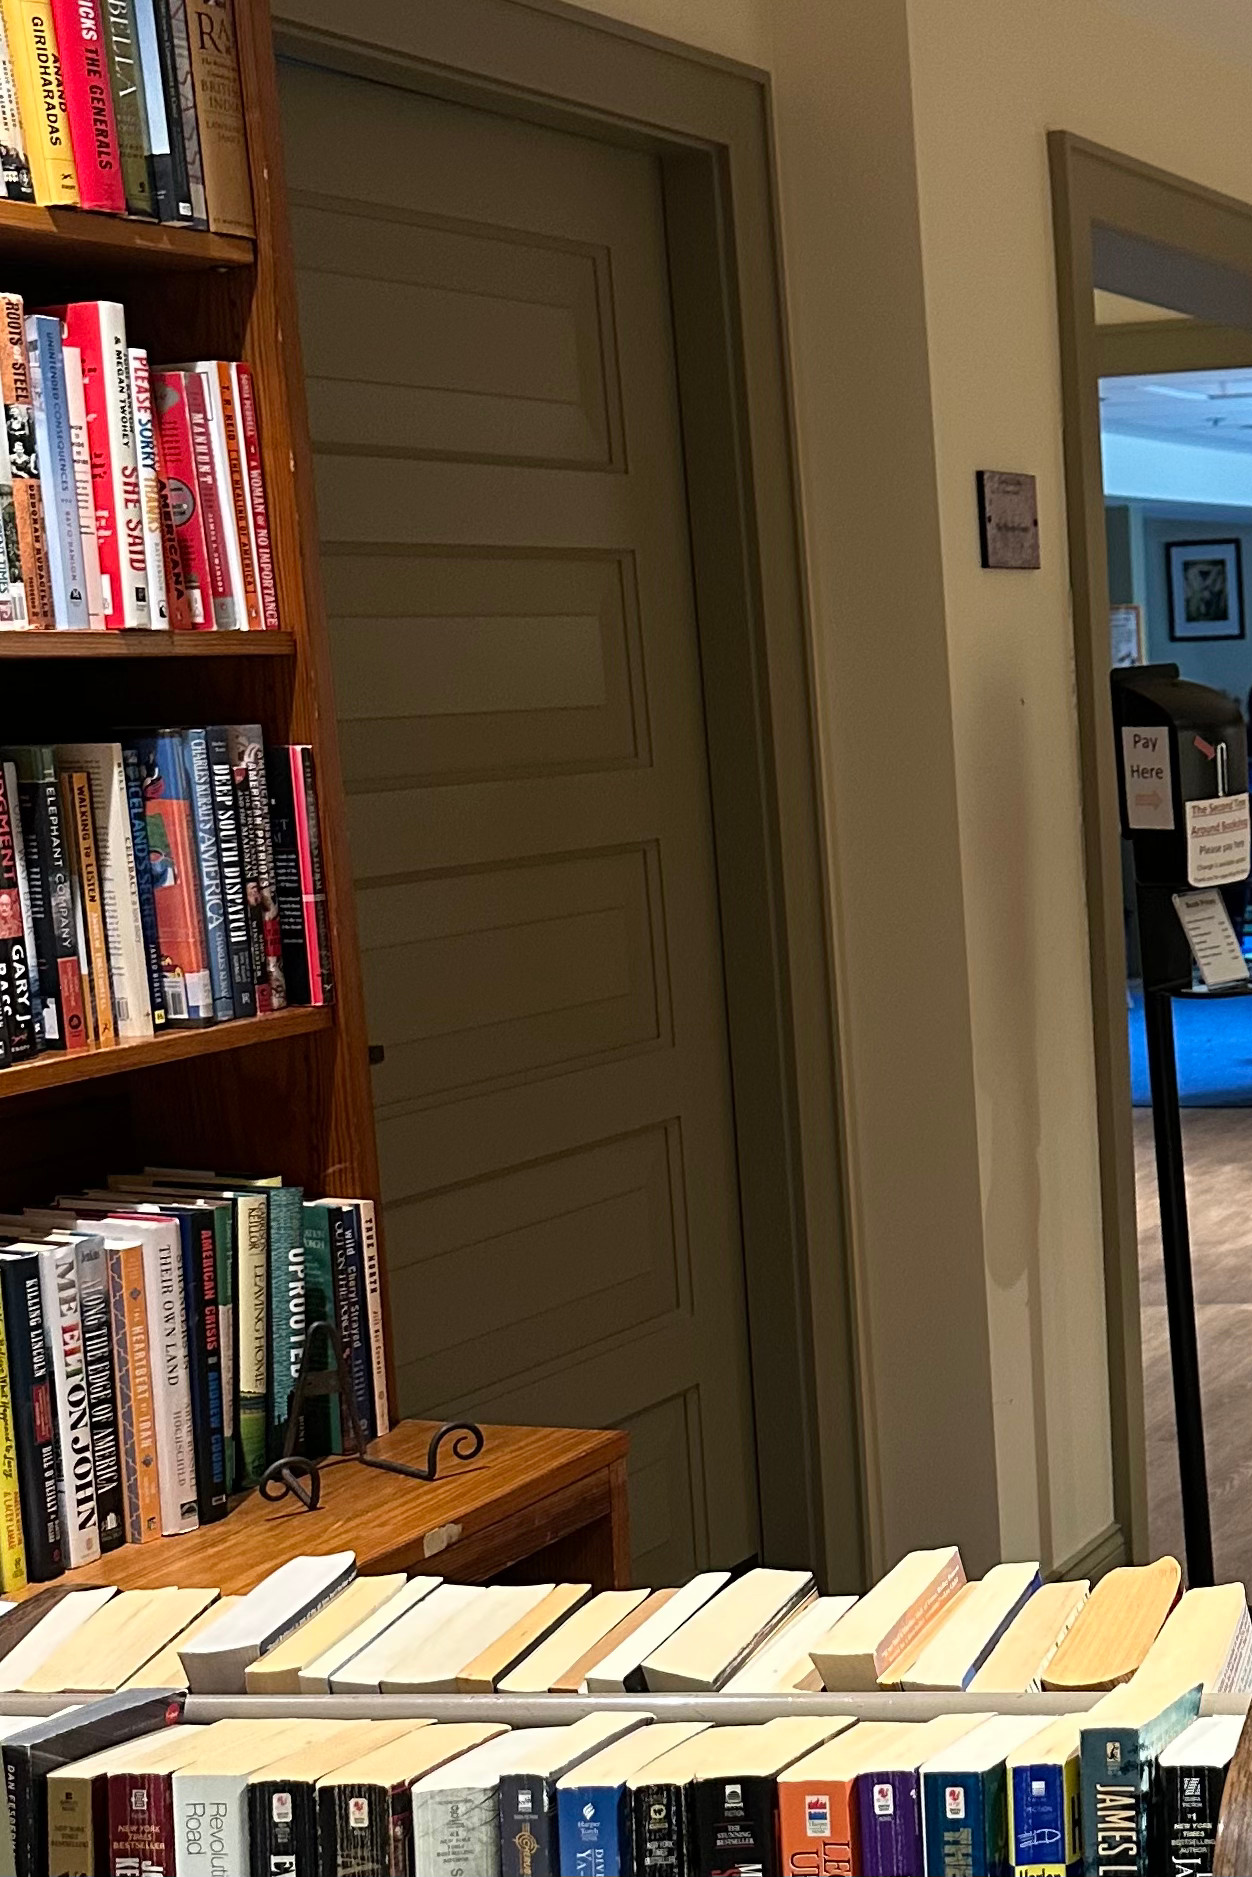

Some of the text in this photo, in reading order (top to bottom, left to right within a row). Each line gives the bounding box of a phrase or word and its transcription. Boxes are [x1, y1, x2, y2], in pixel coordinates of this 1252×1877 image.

[32, 16, 62, 146] GIRIDHARADAS
[78, 0, 113, 170] ICKS THE GENERALS
[5, 302, 23, 346] ROOTS
[12, 363, 31, 402] STEEL
[115, 350, 125, 393] MEGAN
[120, 398, 130, 448] TWOHEY
[46, 332, 69, 492] UNINTENDED CONSEQUENCES
[225, 414, 236, 441] REID
[133, 356, 161, 533] PLEASE SORRY THANKS
[191, 412, 213, 484] MANHUNT
[250, 470, 266, 513] WOMAN
[122, 466, 147, 571] SHE SAID
[157, 479, 185, 601] AMERICANA
[239, 525, 248, 538] OF
[257, 529, 269, 546] NO
[241, 542, 254, 586] AMERICA
[258, 549, 279, 626] IMPORTANCE
[190, 739, 211, 783] CHARLES
[1133, 734, 1158, 752] Pay
[213, 764, 233, 806] DEEP
[1131, 764, 1164, 780] Here
[77, 786, 97, 903] WALKING LISTEN
[218, 810, 239, 863] SOUTH
[248, 762, 269, 887] AMERICAN PATRIOTS
[46, 787, 63, 867] ELEPHANT
[55, 873, 73, 948] COMPANY
[200, 832, 225, 930] AMERICA
[224, 867, 248, 943] DISPATCH
[12, 945, 31, 1028] GARY J.
[335, 1221, 344, 1246] OUT
[345, 1229, 355, 1256] wild
[336, 1249, 346, 1270] ON
[365, 1218, 379, 1294] TRUE NORTH
[26, 1278, 42, 1326] KILLING
[81, 1278, 107, 1327] ALONG
[247, 1207, 267, 1389] KEILLOR LEAVING HOME
[347, 1265, 359, 1302] Cheryl
[158, 1244, 179, 1386] THEIR OWN LAND
[340, 1301, 351, 1342] PORCH
[351, 1304, 362, 1348] Strayed
[30, 1329, 47, 1377] LINCOLN
[85, 1327, 109, 1361] THE
[201, 1230, 223, 1483] AMERICAN CRISIS ANDREW CUOMO
[55, 1262, 97, 1531] ME ELTON JOHN
[88, 1362, 112, 1404] EDGE
[131, 1326, 153, 1448] HEARTBEAT IRAN
[91, 1403, 113, 1422] OF
[42, 1446, 53, 1468] BILL
[93, 1428, 119, 1494] AMERICA
[173, 1410, 186, 1487] HOCHSCHILD
[44, 1469, 58, 1513] O'REILLY
[7, 1764, 15, 1791] DAN
[118, 1825, 161, 1833] NEW YORK
[128, 1833, 152, 1841] TIMES
[185, 1802, 206, 1856] Road
[577, 1821, 601, 1830] Harper
[1096, 1783, 1138, 1856] JAMES
[113, 1841, 165, 1850] BESTSELLER
[789, 1851, 820, 1877] U
[822, 1841, 850, 1877] LE
[1179, 1846, 1207, 1854] AUTHOR
